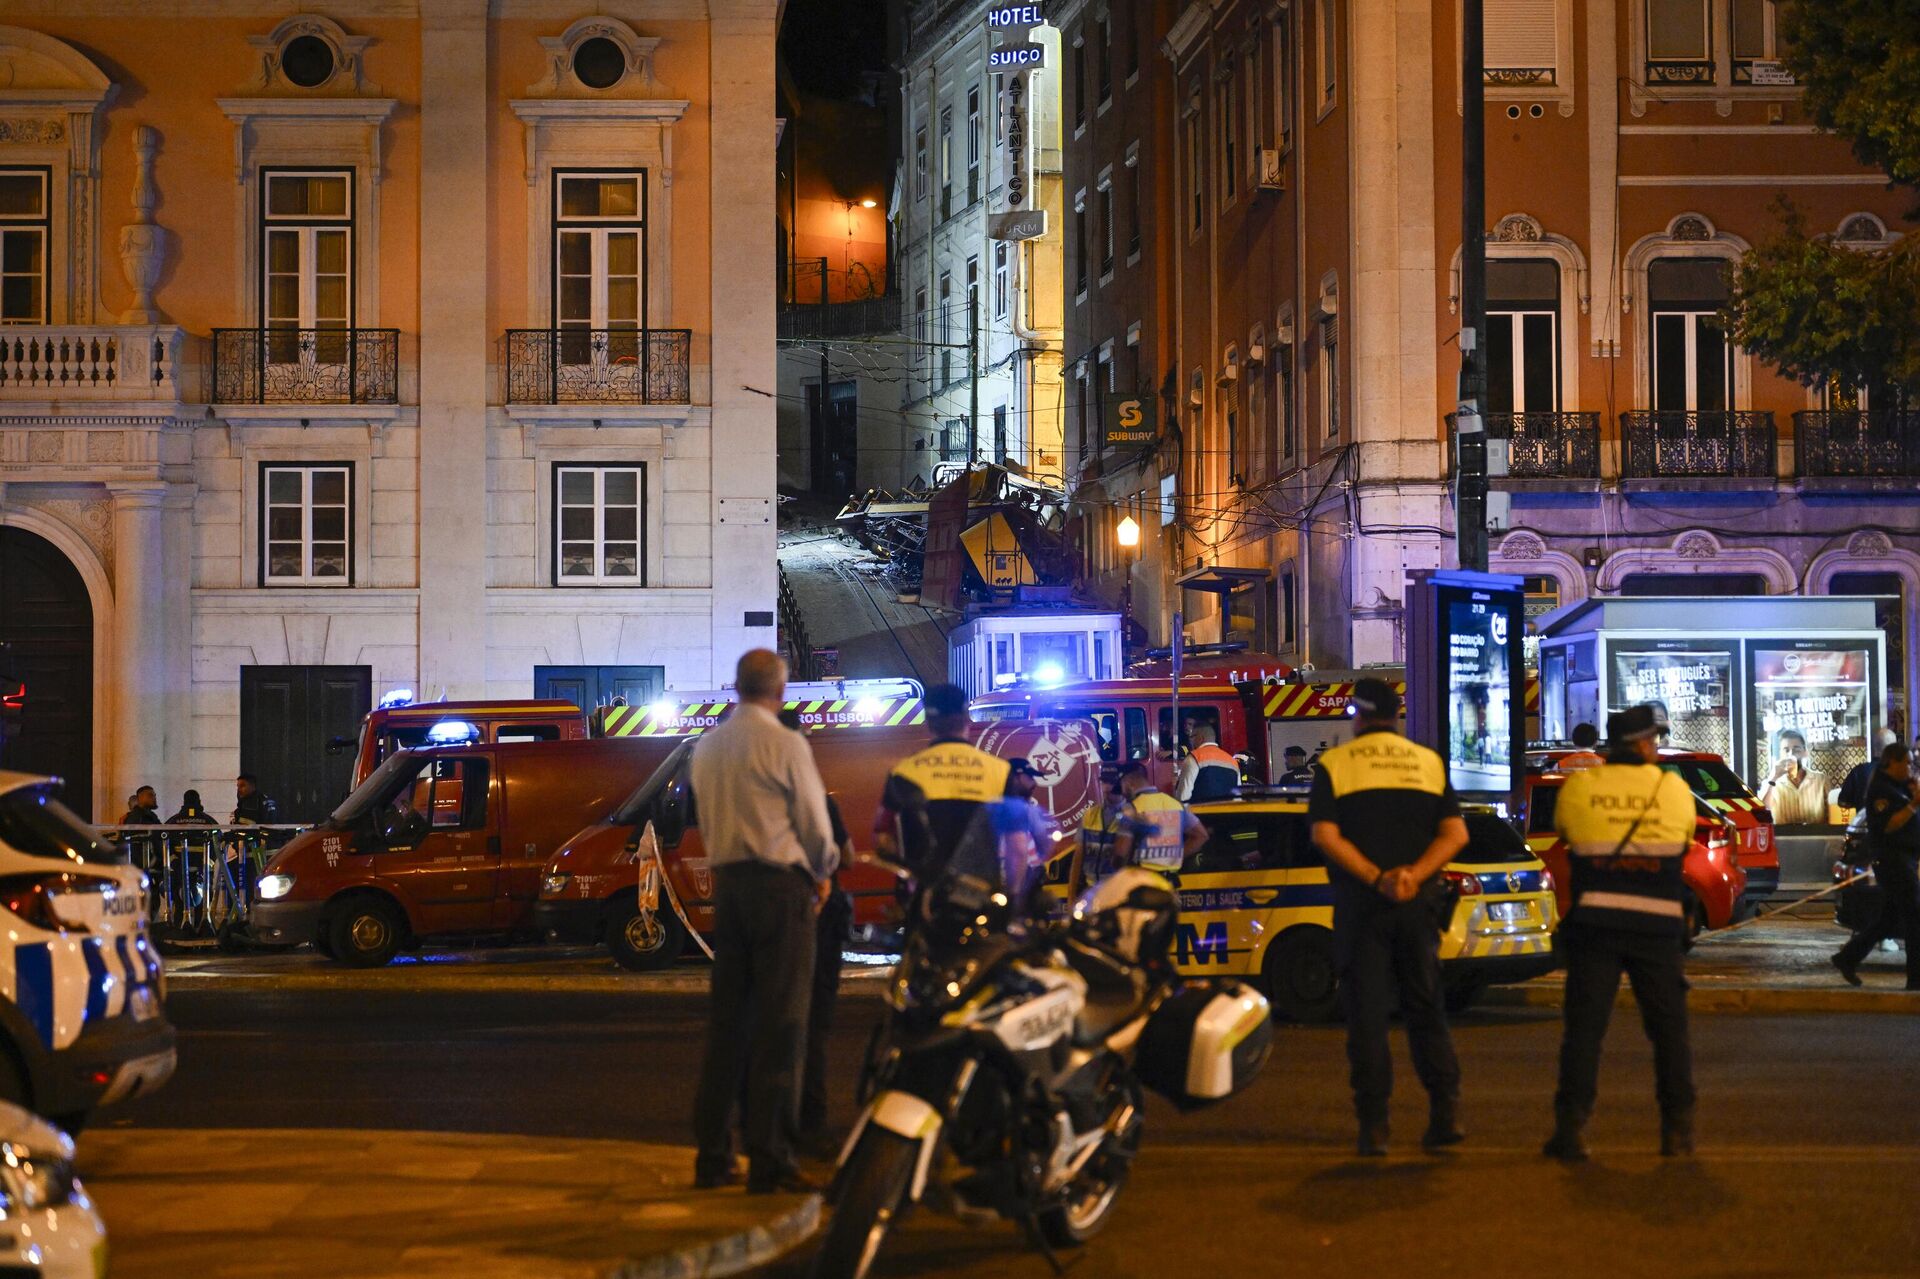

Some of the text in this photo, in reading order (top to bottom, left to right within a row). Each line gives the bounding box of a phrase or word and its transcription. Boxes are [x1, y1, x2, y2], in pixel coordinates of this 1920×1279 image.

[989, 6, 1042, 27] HOTEL
[990, 49, 1040, 65] SUIÇO
[1107, 431, 1152, 441] SUBWAY
[1460, 633, 1485, 649] CORAÇÃO
[1638, 662, 1710, 684] SER PORTUGUÊS
[1647, 683, 1658, 698] SE
[1660, 681, 1699, 698] EXPLICA,
[1669, 694, 1711, 713] SENTE-SE
[1775, 692, 1847, 715] SER PORTUGUÊS
[826, 712, 874, 724] LISBOA
[1783, 714, 1796, 729] SE
[1796, 712, 1836, 729] EXPLICA,
[1807, 725, 1850, 743] SENTE-SE
[1608, 816, 1662, 826] munipal
[1840, 807, 1849, 824] RES
[1062, 820, 1073, 828] DE
[322, 837, 340, 846] 2101
[326, 852, 339, 860] MA
[328, 860, 337, 868] 11
[1206, 893, 1217, 906] DA
